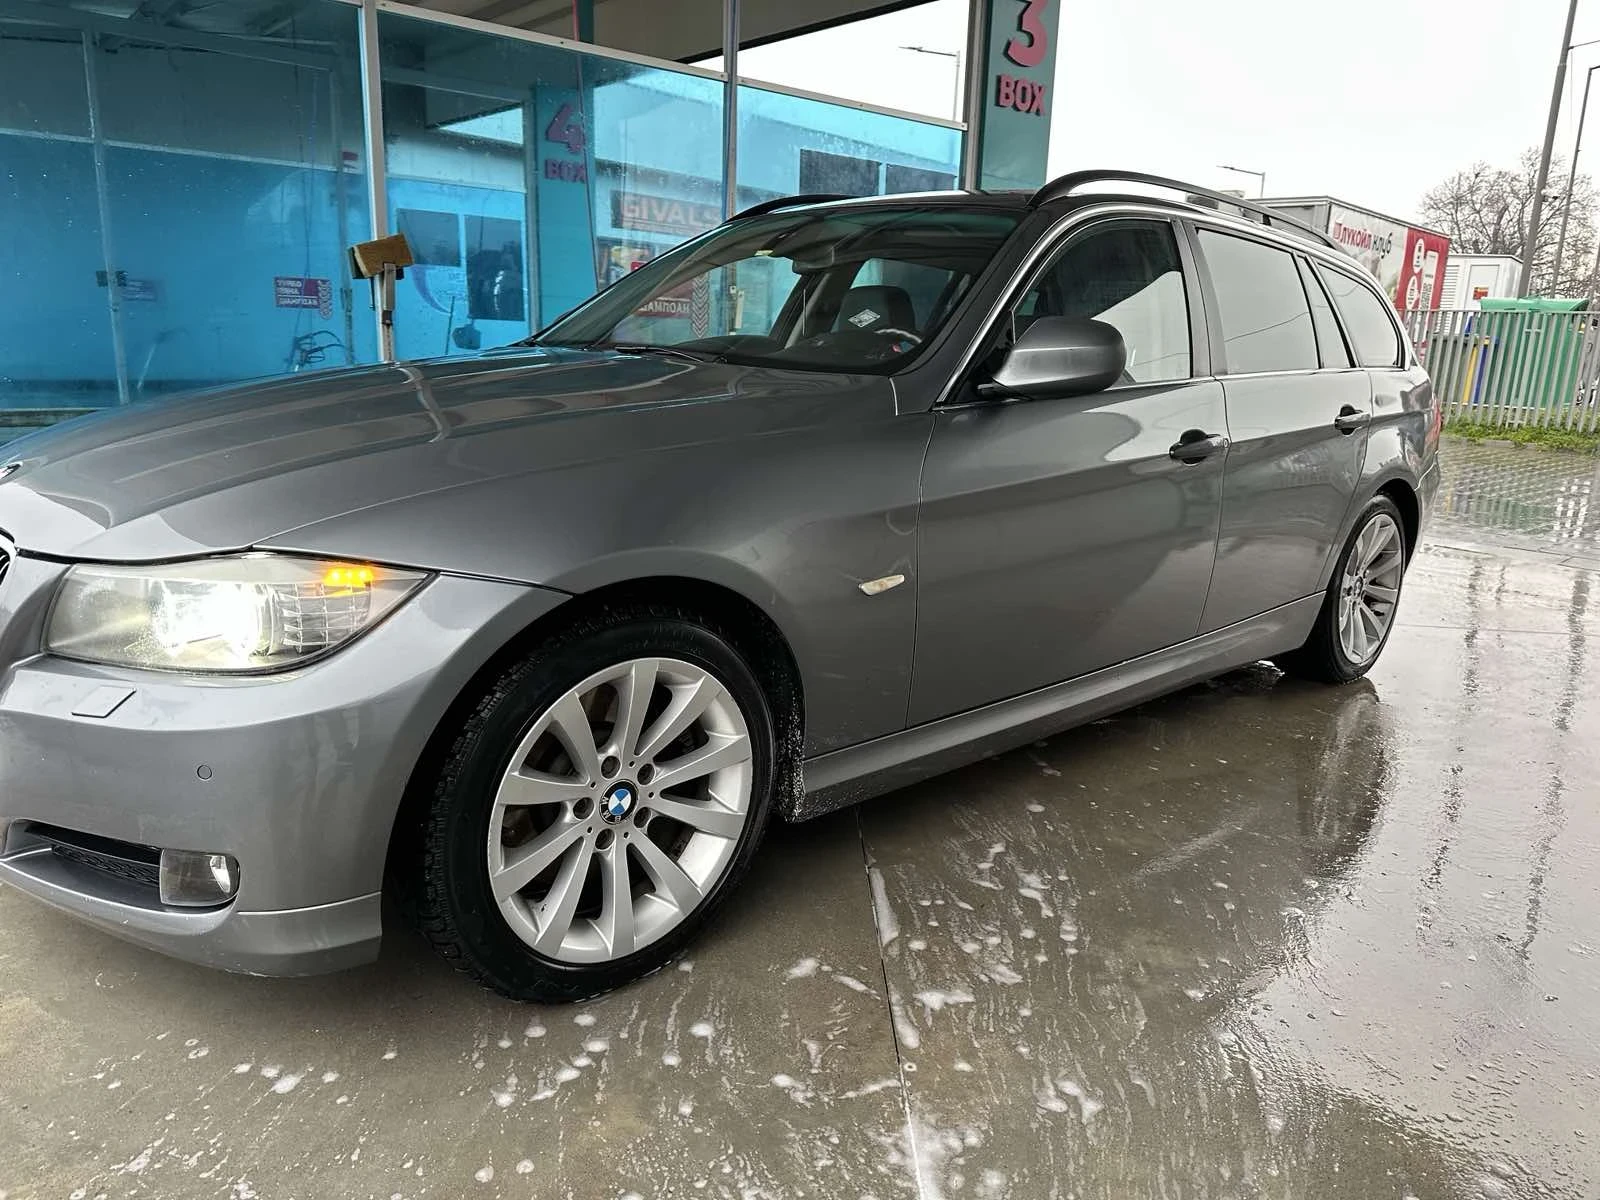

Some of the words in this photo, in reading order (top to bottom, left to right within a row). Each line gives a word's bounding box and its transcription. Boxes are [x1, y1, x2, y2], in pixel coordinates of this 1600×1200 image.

[1003, 0, 1048, 67] 3
[996, 74, 1045, 116] BOX
[546, 104, 585, 154] 4
[545, 159, 586, 183] BOX
[1340, 227, 1372, 249] ЛУКОЙЛ
